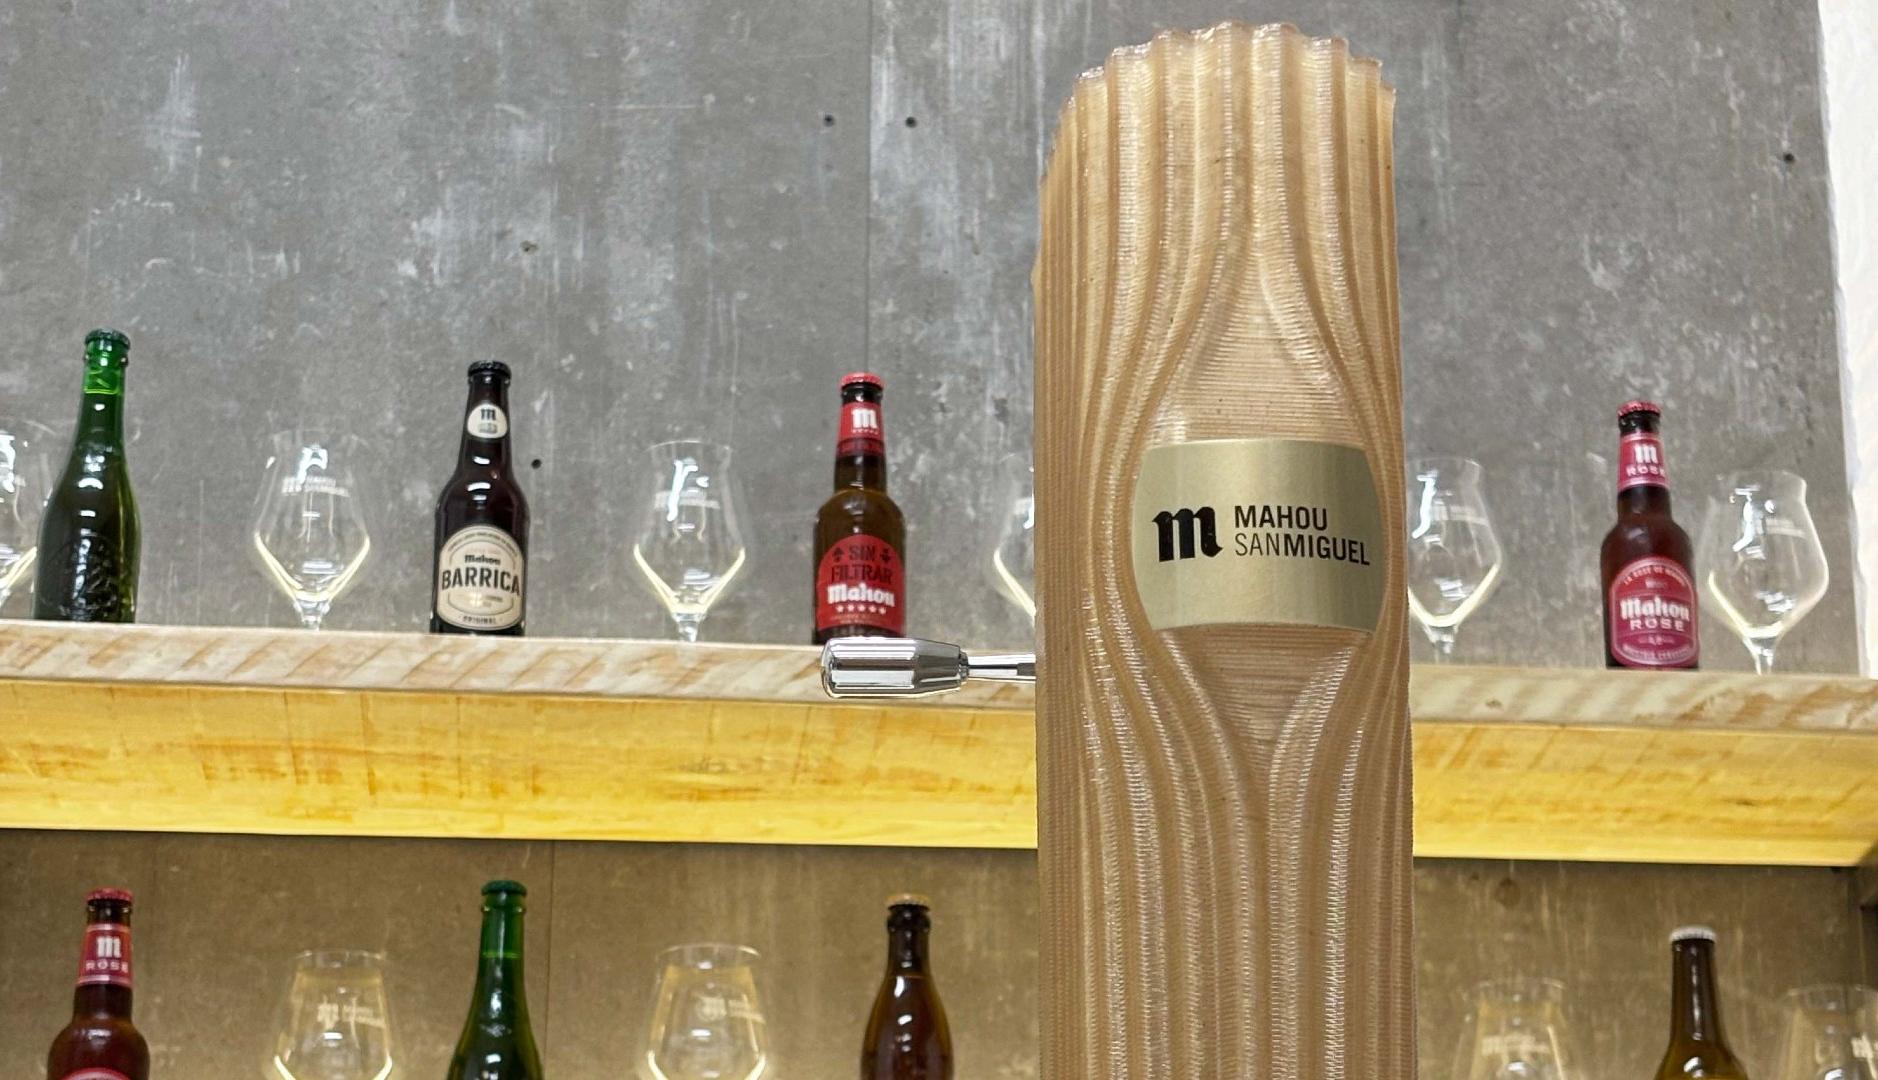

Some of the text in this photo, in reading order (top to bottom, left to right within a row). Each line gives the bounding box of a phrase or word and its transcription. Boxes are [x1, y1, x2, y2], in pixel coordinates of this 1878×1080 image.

[1234, 505, 1328, 531] MAHOU
[849, 545, 876, 562] SIN
[1234, 532, 1371, 566] SANMIGUEL
[441, 566, 520, 597] BARRICA
[831, 563, 894, 585] FILTRAR
[827, 582, 895, 608] Mahou
[1620, 595, 1690, 622] Mahou
